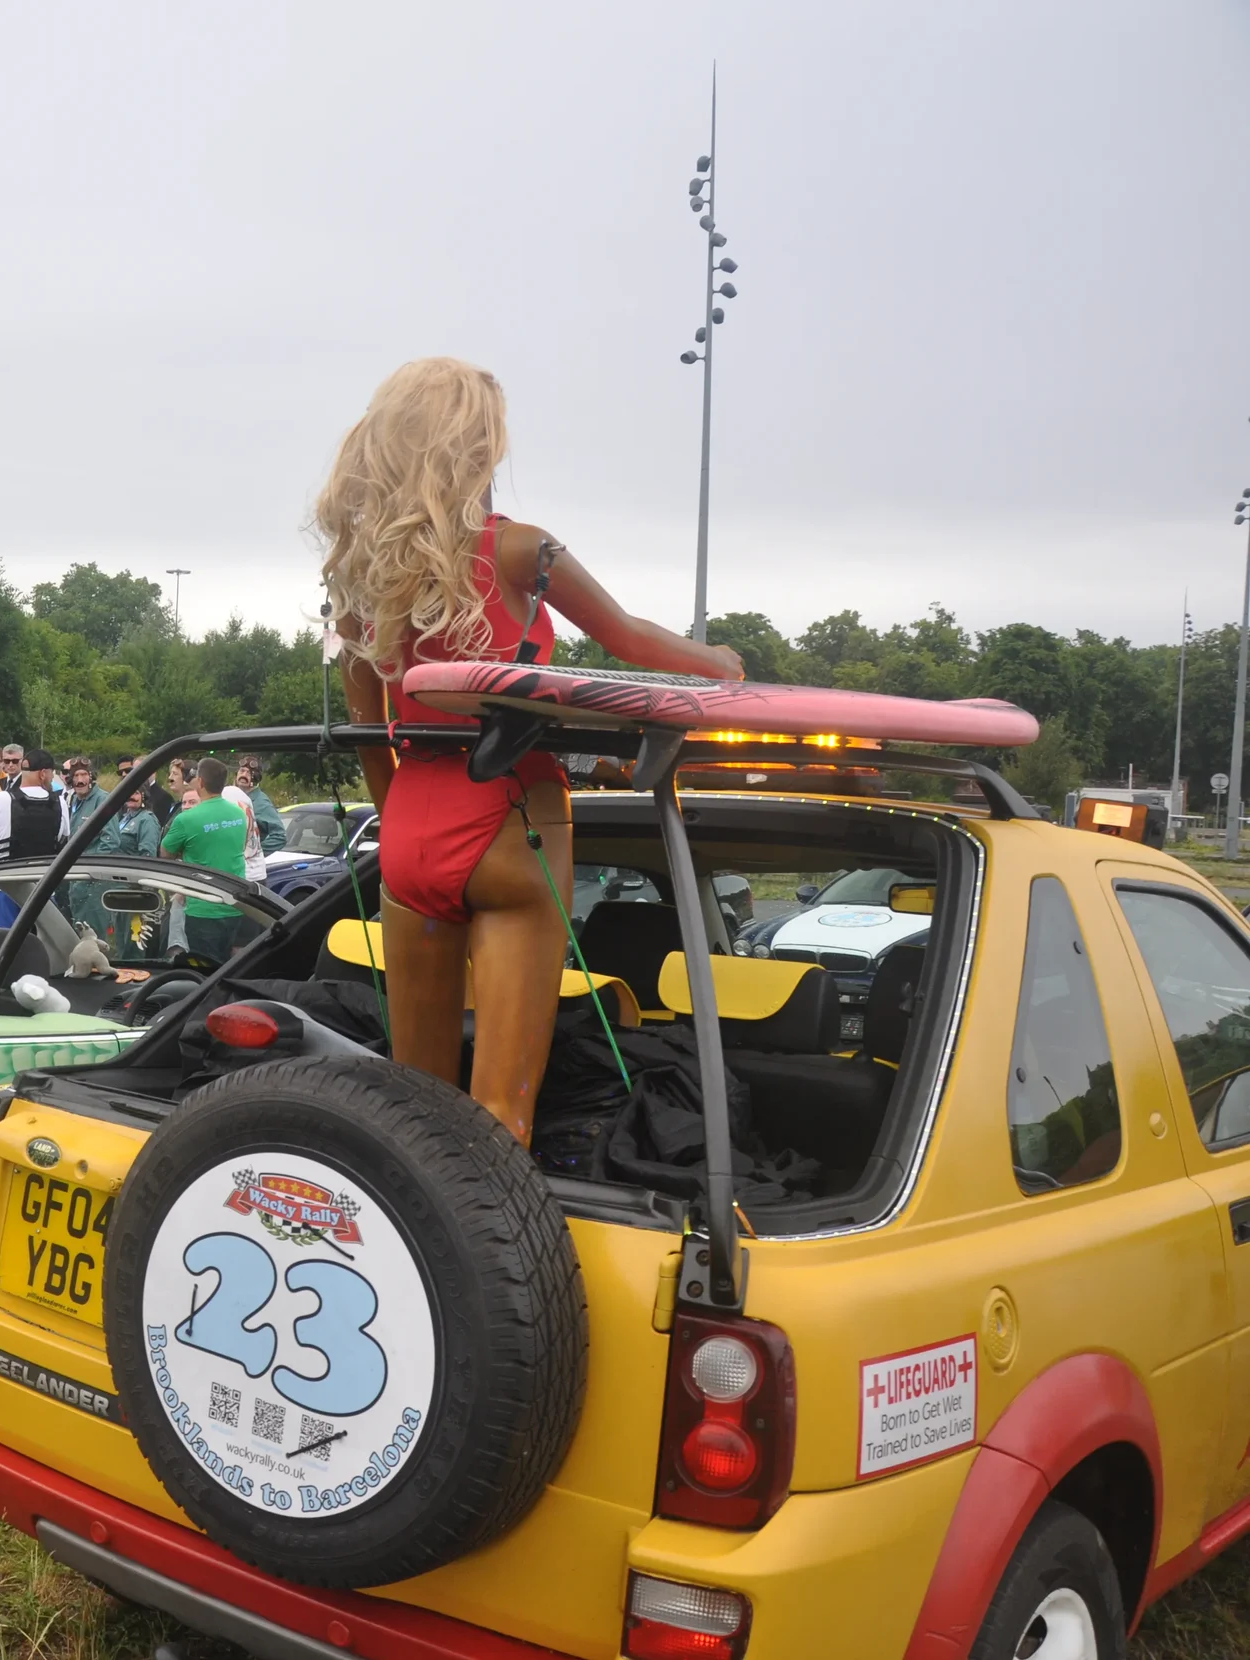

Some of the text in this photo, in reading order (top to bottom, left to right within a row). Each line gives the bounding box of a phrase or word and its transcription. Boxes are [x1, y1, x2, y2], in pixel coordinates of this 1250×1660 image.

[33, 1141, 52, 1153] LAND
[21, 1173, 116, 1248] GF04
[248, 1187, 341, 1226] Wacky Rally
[26, 1234, 96, 1306] YBG
[175, 1231, 388, 1417] 23
[886, 1354, 958, 1405] LIFEGUARD
[146, 1323, 422, 1513] Brooklands to Barcelona
[880, 1394, 963, 1433] Born to Get Wet
[225, 1442, 306, 1481] wackyrally.co.uk
[865, 1416, 973, 1462] Trained to Save Lives
